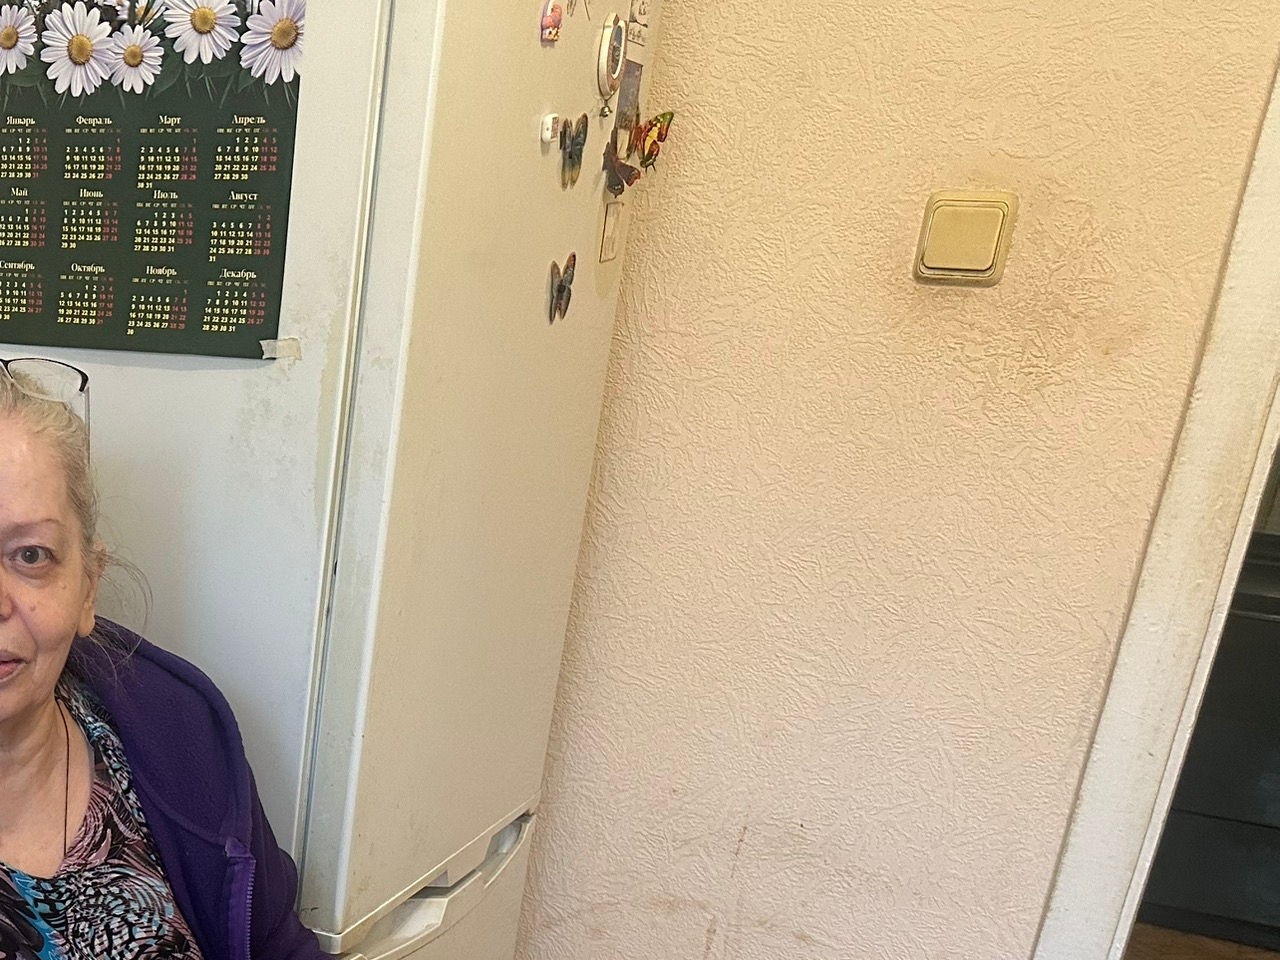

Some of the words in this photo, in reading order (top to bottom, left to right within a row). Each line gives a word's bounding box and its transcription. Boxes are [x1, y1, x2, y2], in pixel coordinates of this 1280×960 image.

[6, 116, 36, 127] Январь
[76, 115, 113, 127] Февраль
[159, 115, 182, 126] Март
[231, 114, 266, 126] Апрель
[11, 187, 28, 196] Май
[80, 188, 104, 198] Июнь
[153, 189, 178, 199] Июль
[228, 191, 258, 202] Август
[71, 263, 106, 274] Октябрь
[146, 265, 177, 277] Ноябрь
[219, 268, 257, 280] Декабрь
